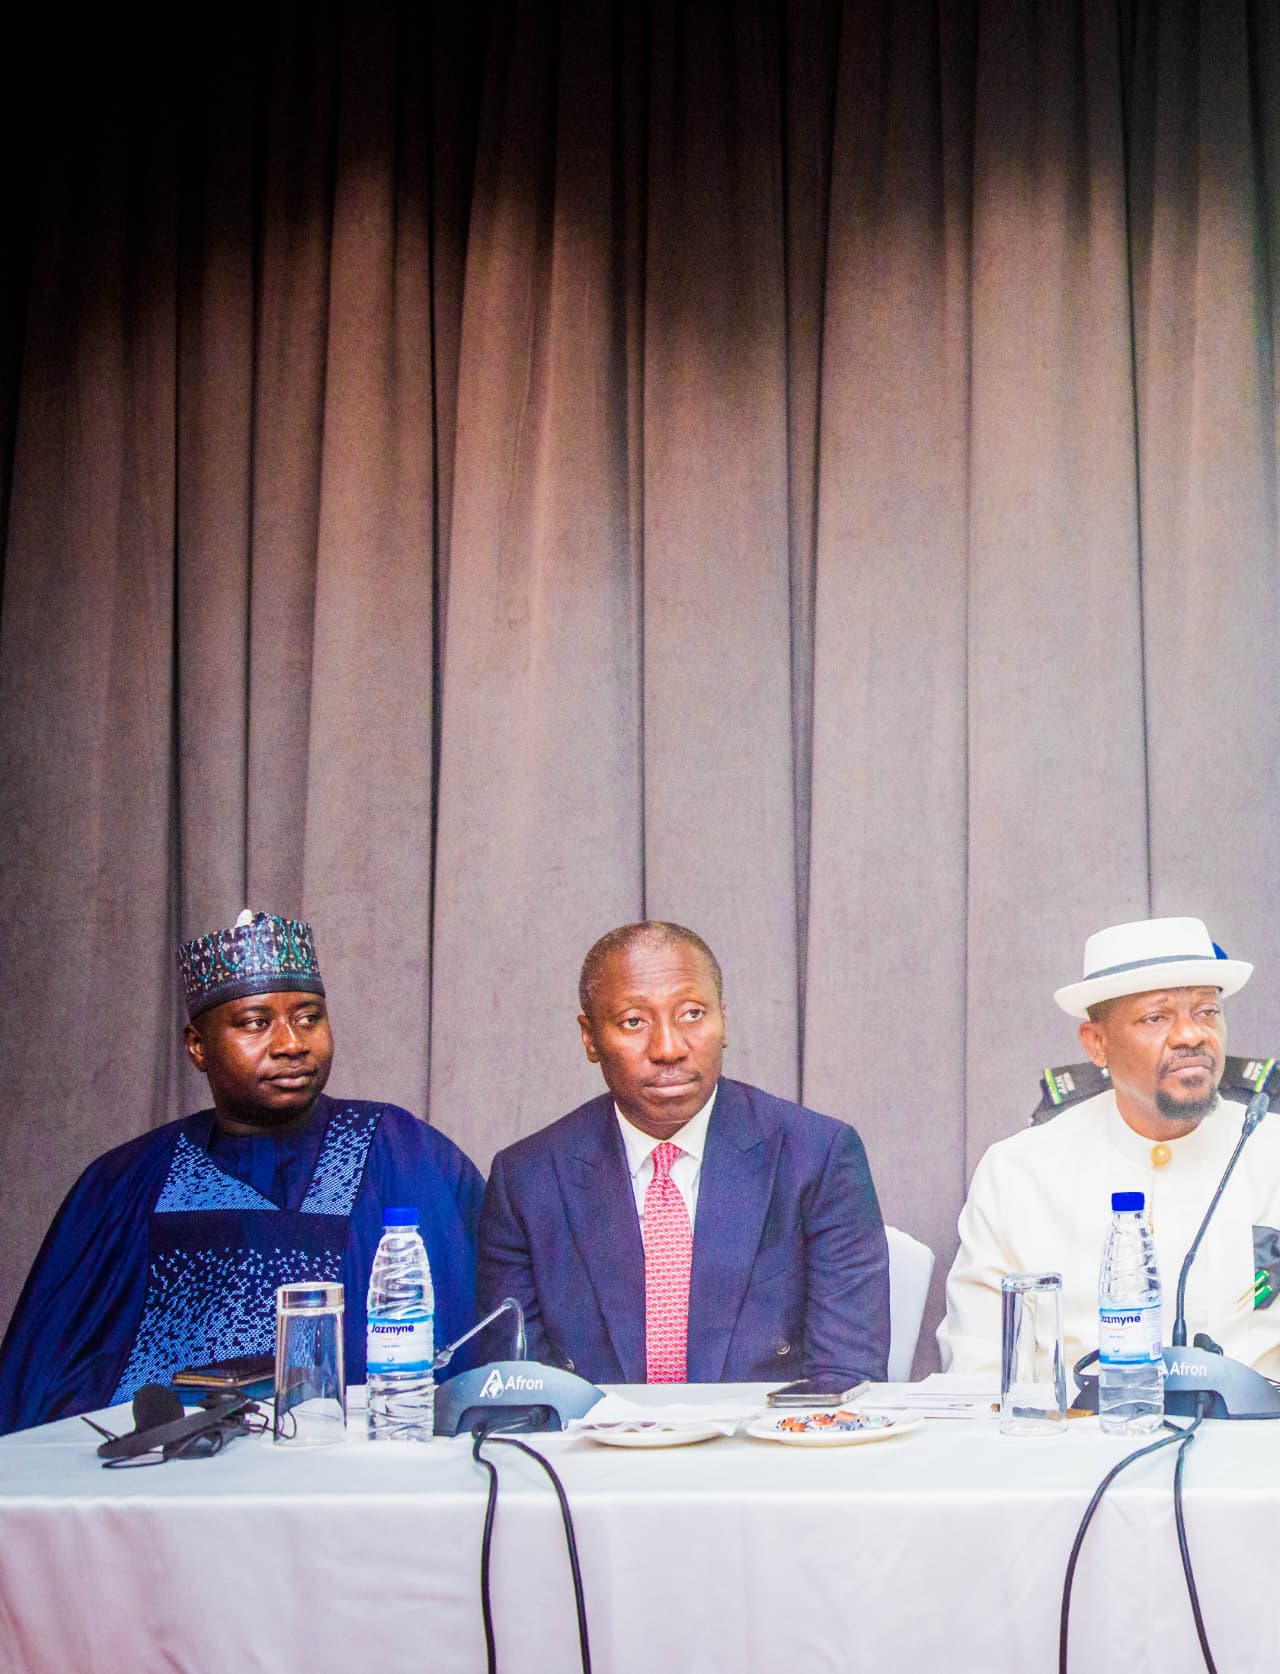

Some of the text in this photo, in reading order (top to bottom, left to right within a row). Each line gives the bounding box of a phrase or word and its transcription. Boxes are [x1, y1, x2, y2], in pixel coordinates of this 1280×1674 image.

[371, 1323, 415, 1336] Jazmyne
[1169, 1361, 1208, 1376] Afron
[504, 1375, 544, 1391] Afron
